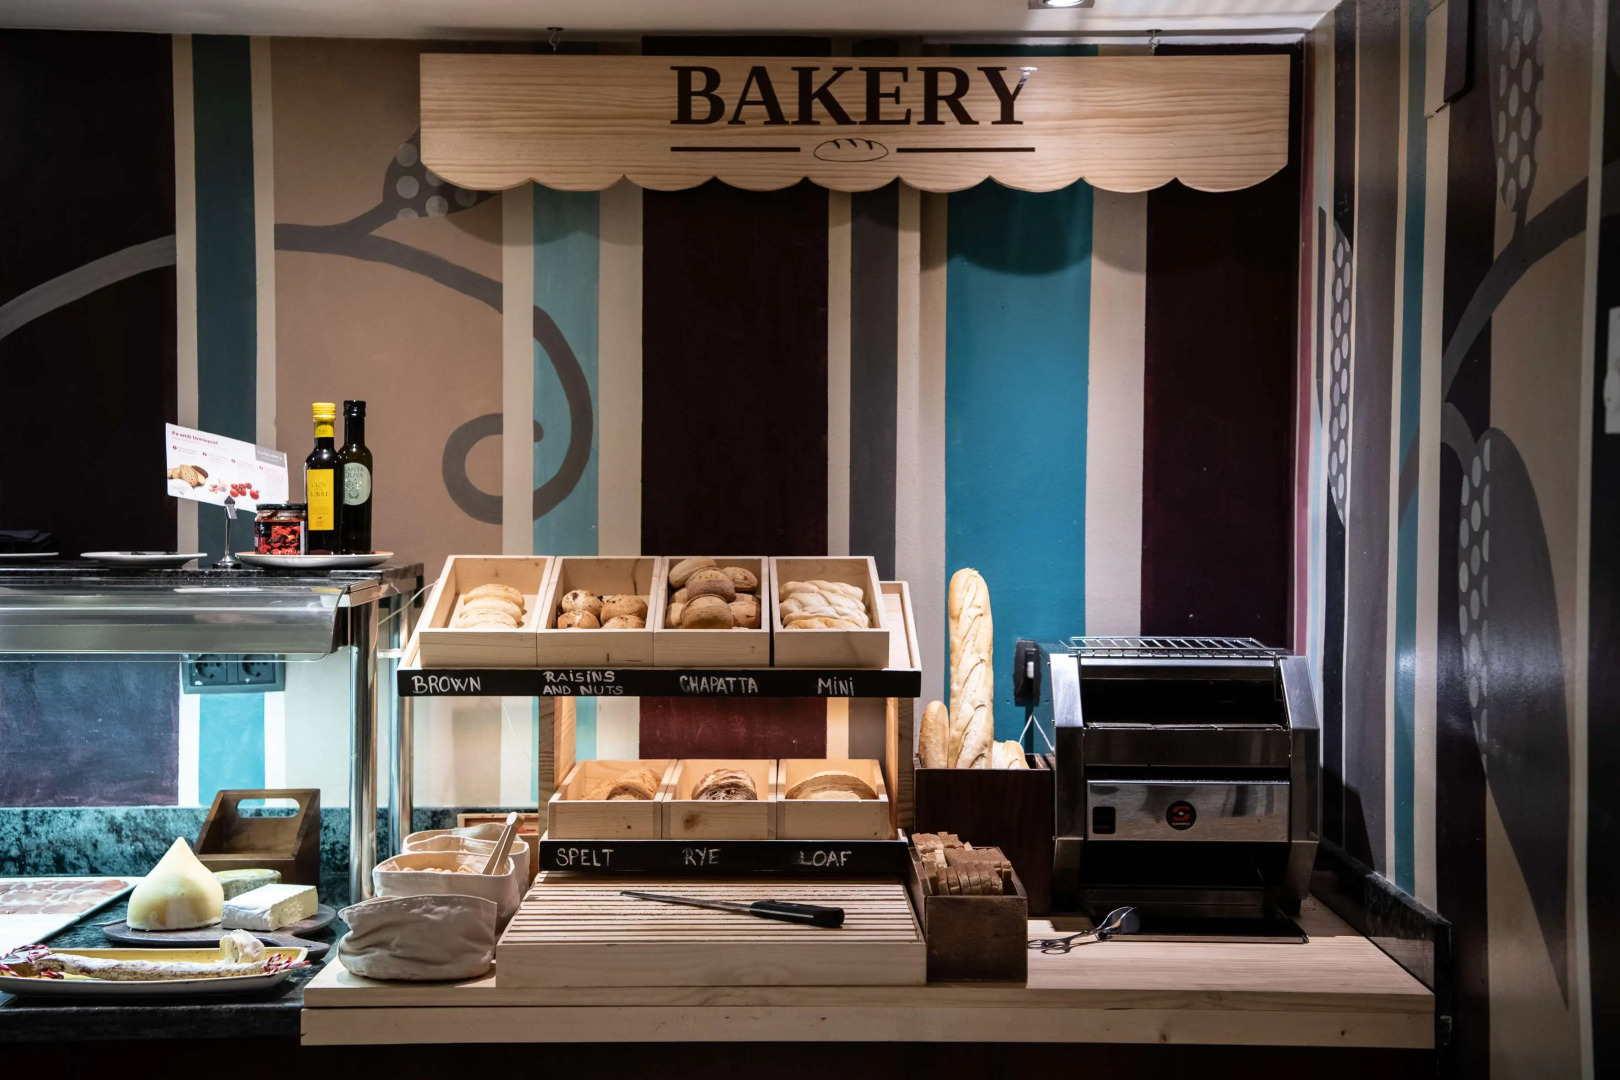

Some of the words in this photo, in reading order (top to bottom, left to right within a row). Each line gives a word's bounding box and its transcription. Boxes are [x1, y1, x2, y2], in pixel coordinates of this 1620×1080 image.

[670, 66, 1038, 125] BAKERY
[411, 675, 482, 694] BROWN
[543, 684, 572, 695] AND
[580, 684, 624, 696] NUTS
[679, 675, 759, 694] CHAPATTA
[556, 847, 615, 867] SPELT
[682, 847, 722, 867] RYE
[799, 850, 852, 868] LOAF
